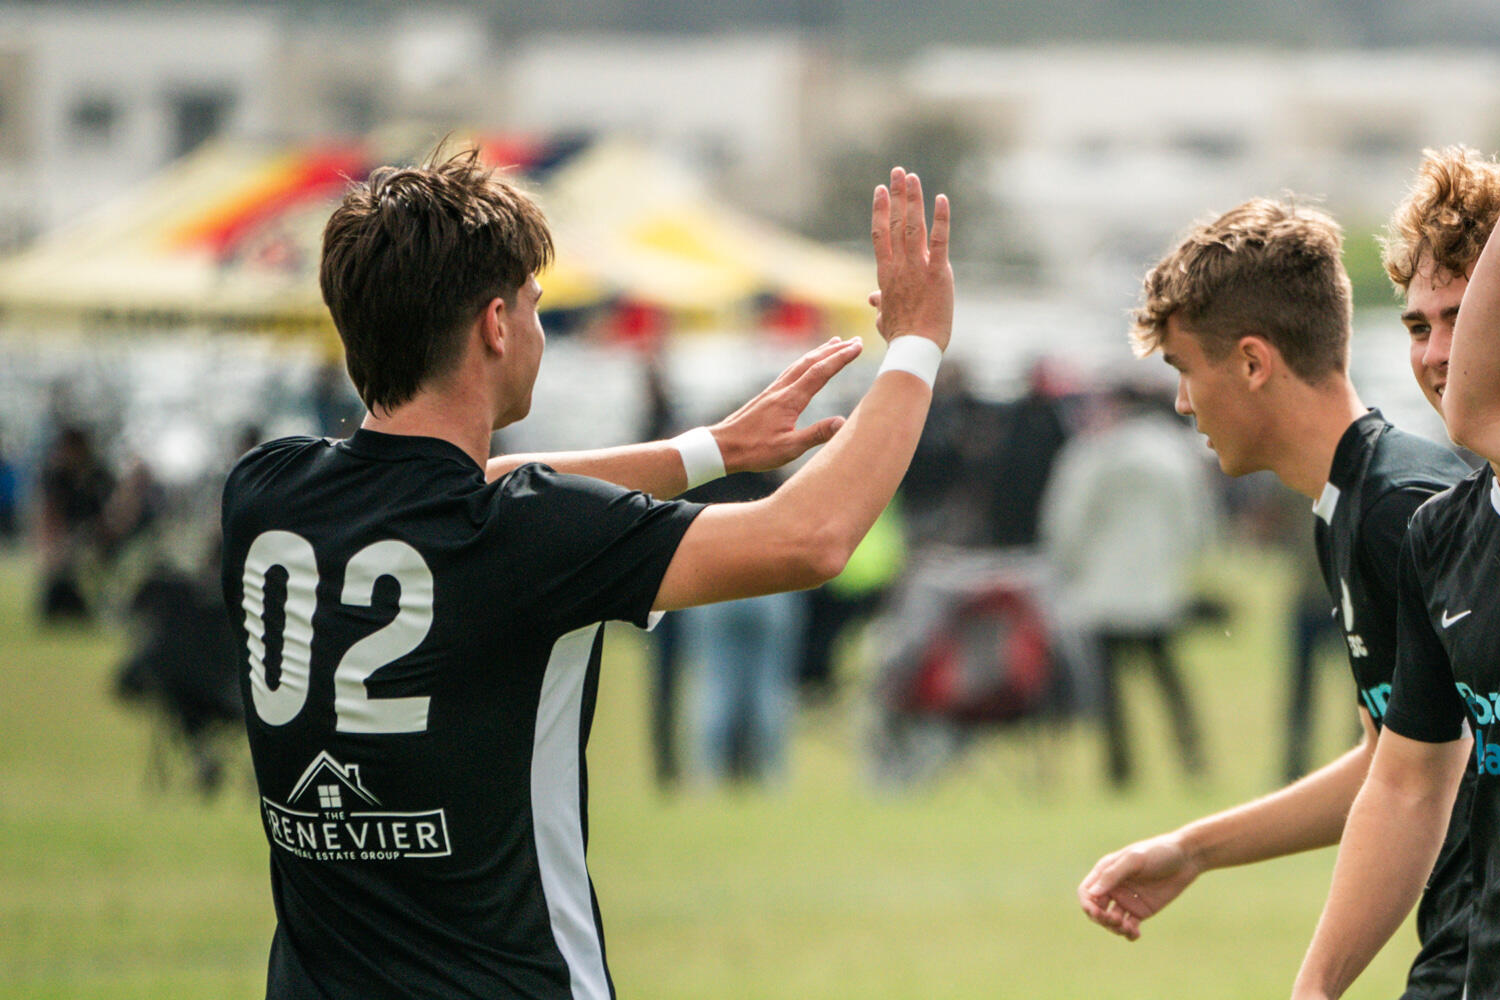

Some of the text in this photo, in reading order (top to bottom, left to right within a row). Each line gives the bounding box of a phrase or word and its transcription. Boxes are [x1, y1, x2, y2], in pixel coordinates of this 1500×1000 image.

[242, 530, 434, 734] 02
[324, 811, 345, 821] THE
[316, 851, 356, 861] ESTATE
[360, 851, 400, 860] GROUP
